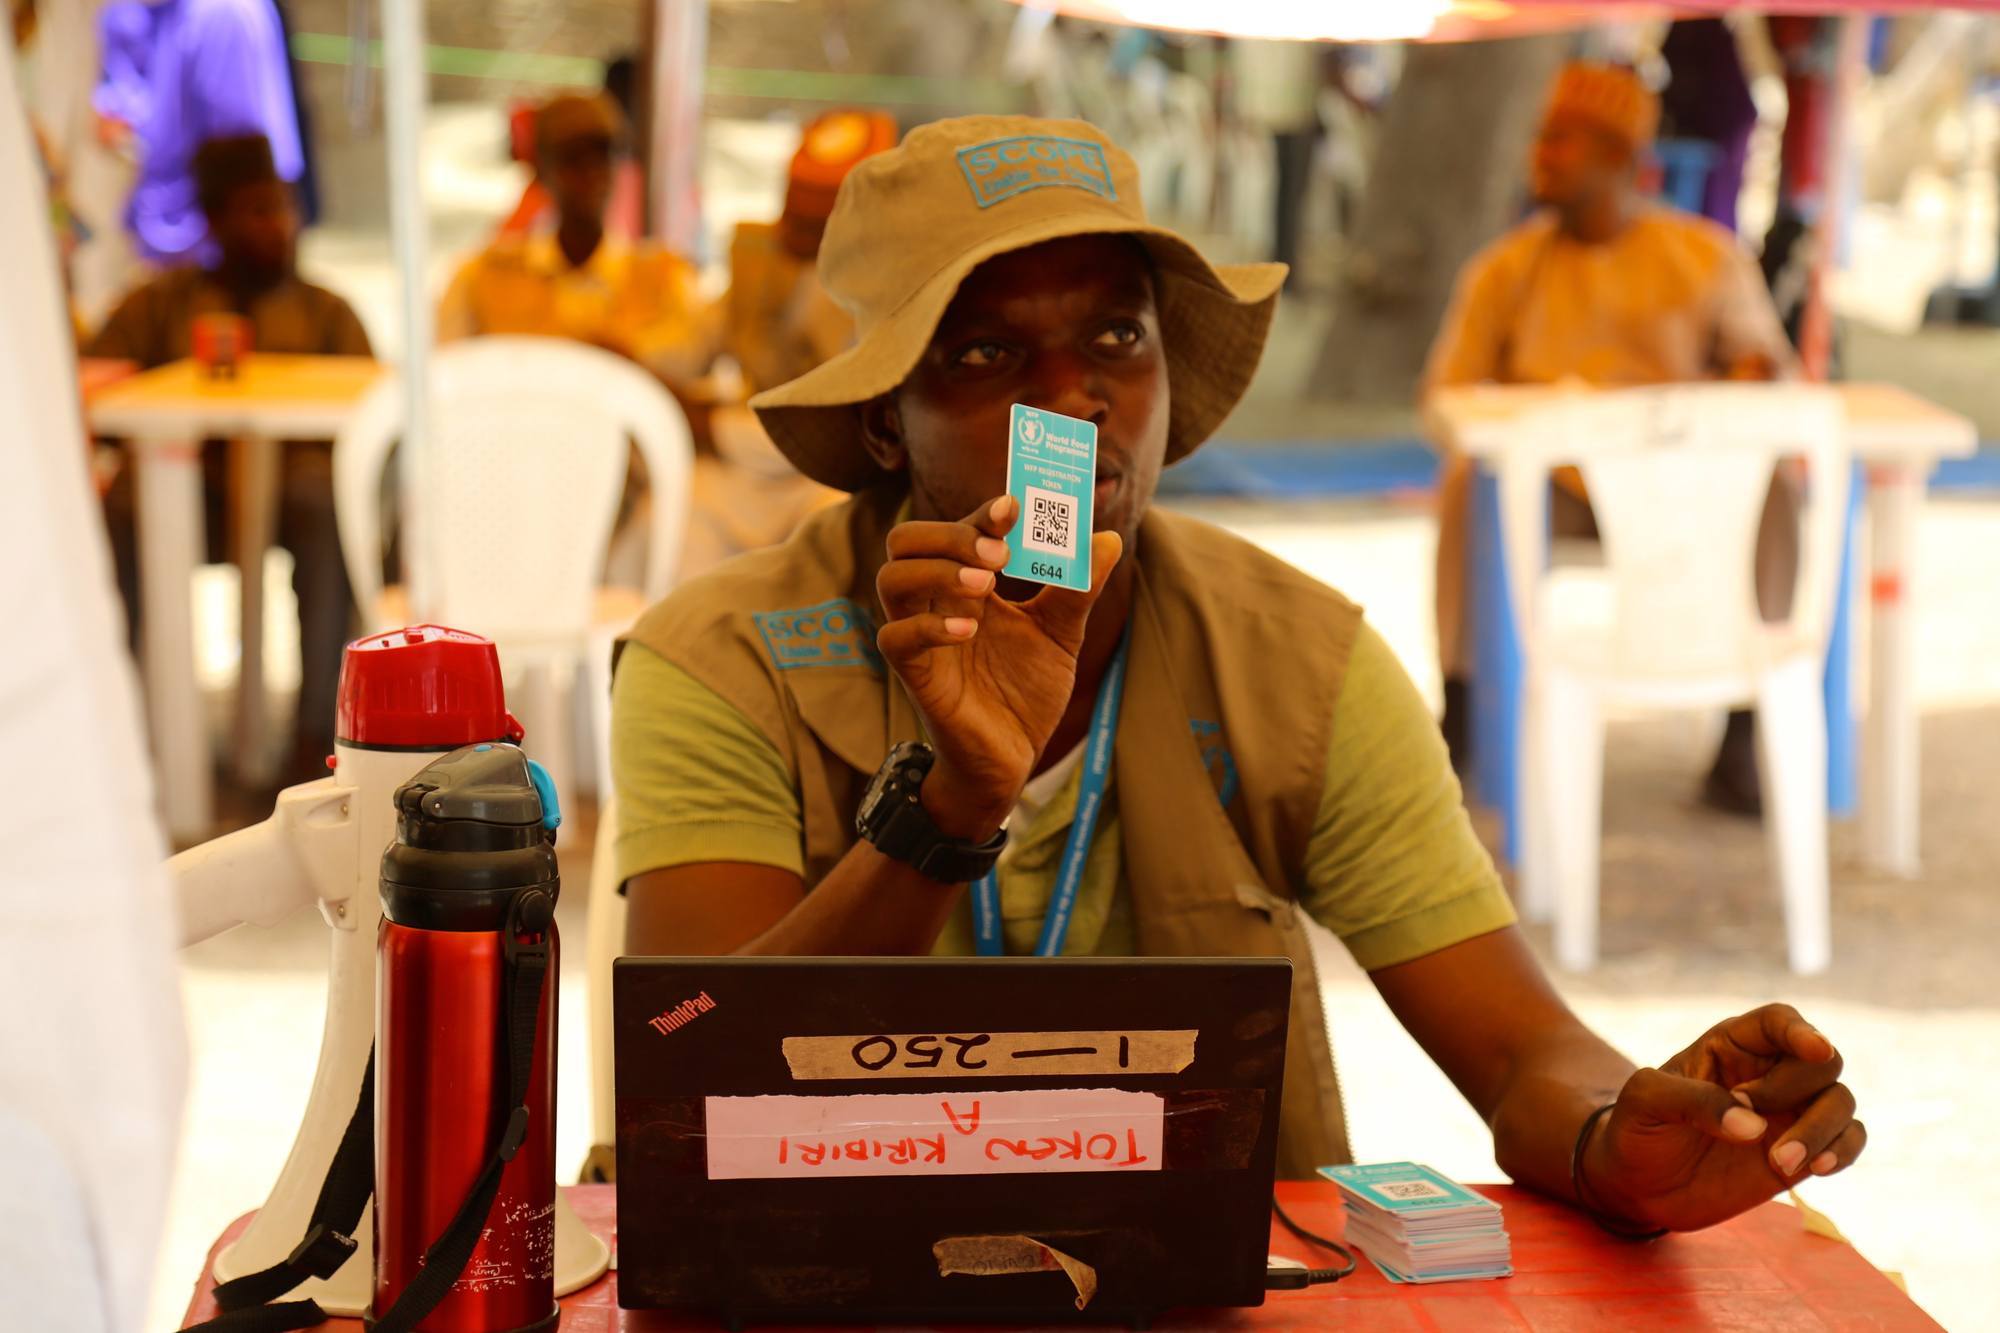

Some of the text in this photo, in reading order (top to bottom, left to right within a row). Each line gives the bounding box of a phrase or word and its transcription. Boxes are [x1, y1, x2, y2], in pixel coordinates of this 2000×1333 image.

[1045, 432, 1090, 451] World Food
[1045, 440, 1089, 459] Programme
[1031, 561, 1064, 581] 6644
[648, 990, 717, 1036] ThinkPad
[850, 1034, 992, 1072] 250
[940, 1100, 981, 1136] A
